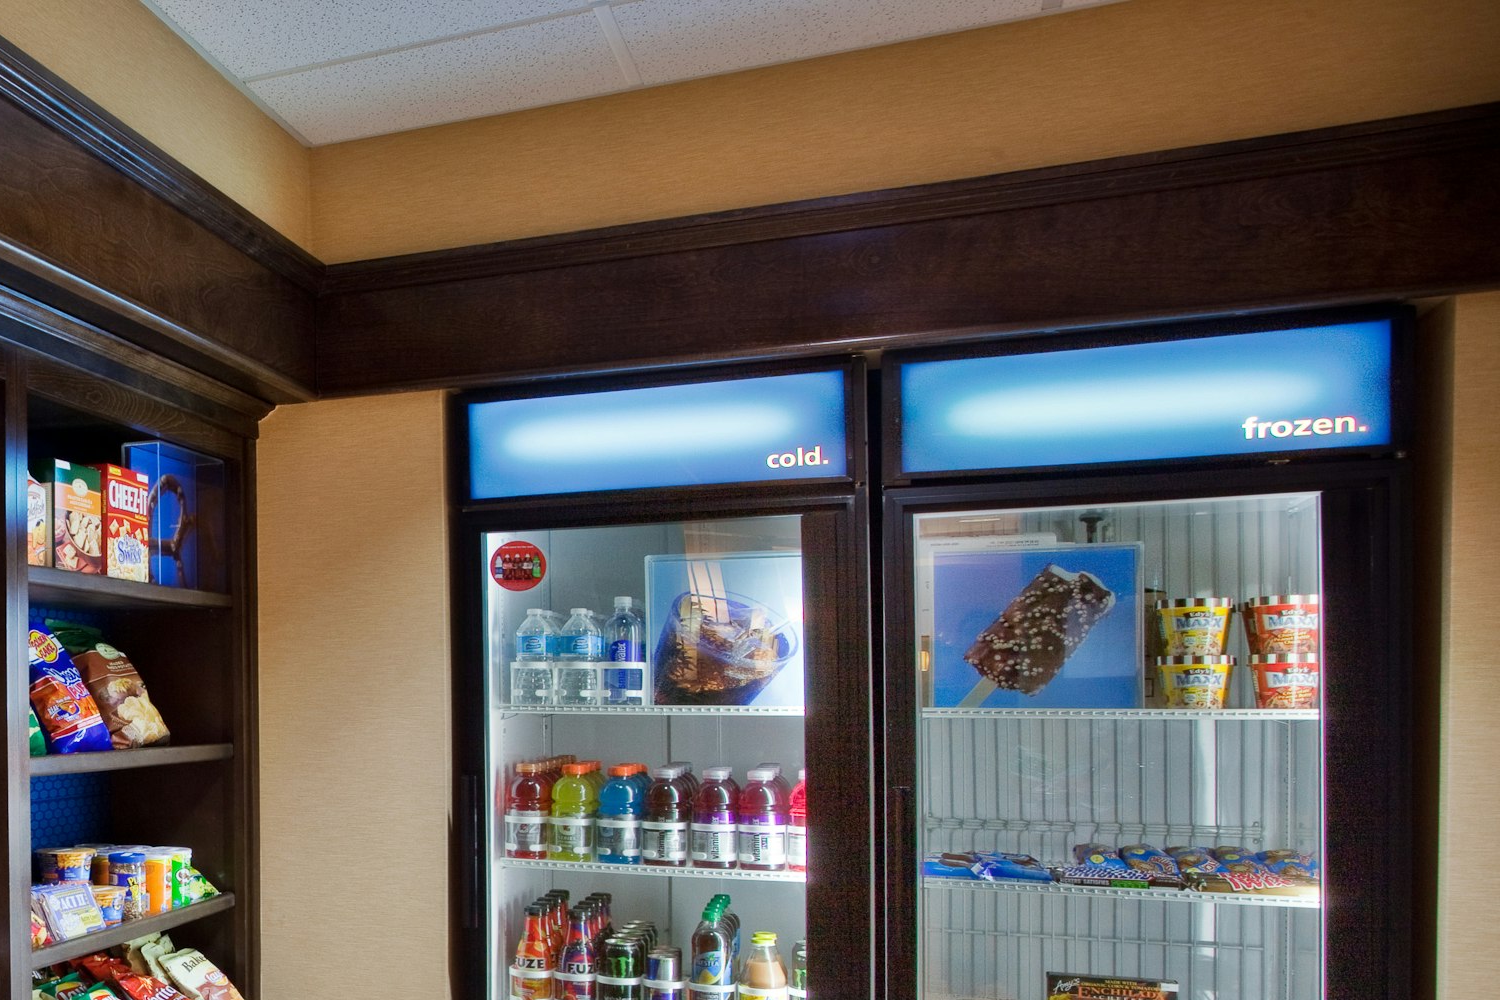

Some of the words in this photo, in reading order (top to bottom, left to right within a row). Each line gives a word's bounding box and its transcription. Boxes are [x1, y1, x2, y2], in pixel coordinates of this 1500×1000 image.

[1241, 415, 1368, 440] frozen.
[766, 445, 829, 469] cold.
[108, 480, 149, 515] CHEEZ-IT
[1176, 617, 1222, 631] MAXX
[1268, 615, 1317, 629] MAXX
[1176, 674, 1222, 688] MAXX
[658, 829, 666, 859] vitamin
[711, 831, 720, 860] vitamin
[753, 832, 761, 862] vitamin
[1218, 871, 1297, 892] TWIX
[514, 957, 545, 970] FUZE
[567, 962, 595, 974] FUZ
